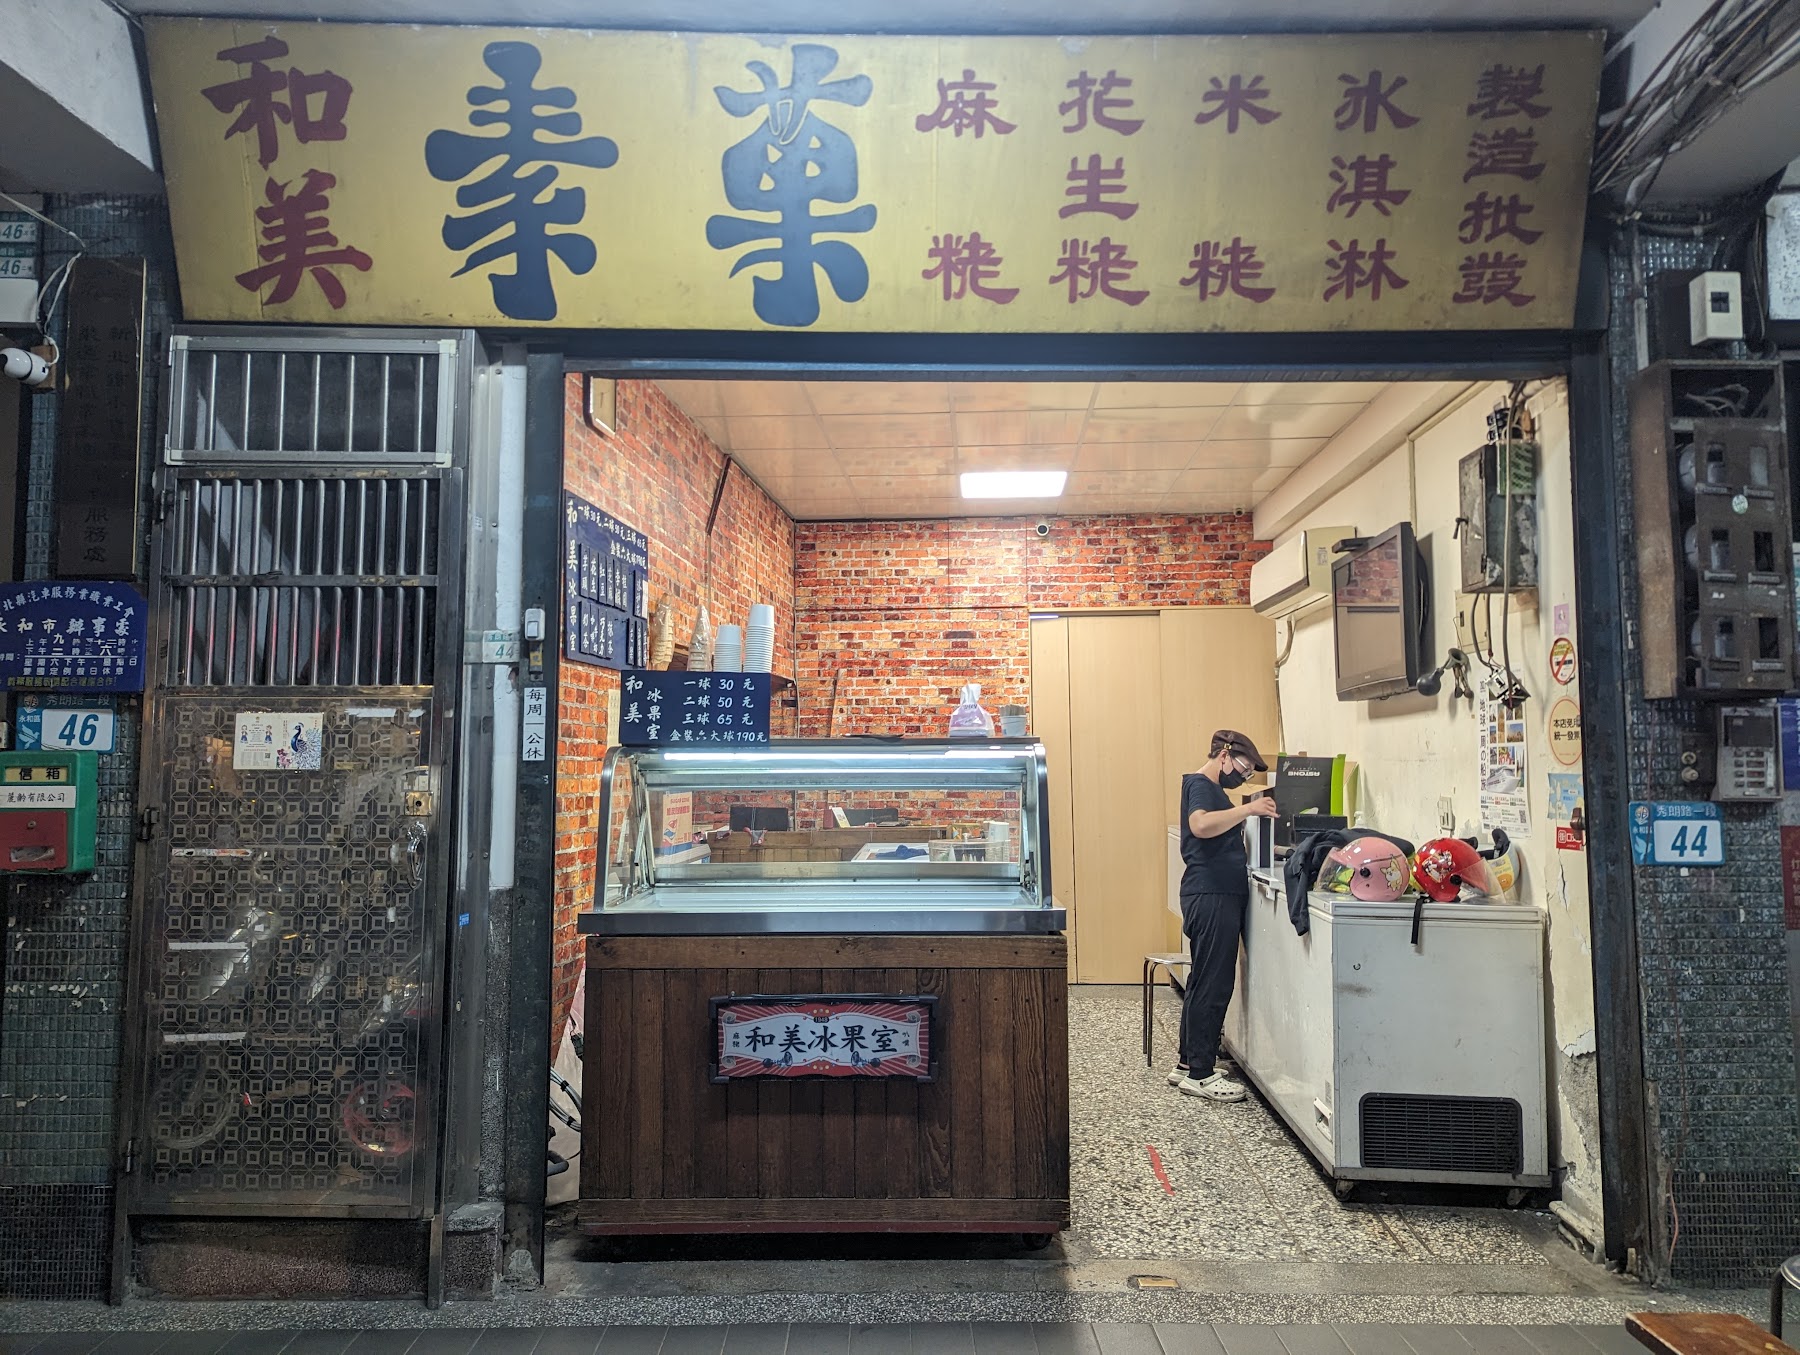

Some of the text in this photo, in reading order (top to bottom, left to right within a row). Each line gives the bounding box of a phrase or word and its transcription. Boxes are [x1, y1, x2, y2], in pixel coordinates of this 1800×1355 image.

[201, 36, 373, 309] 和美
[1322, 70, 1419, 301] 冰淇淋
[1452, 64, 1552, 307] 製造批發
[567, 499, 578, 651] 和美冰果室
[46, 694, 110, 706] 秀朗路一段
[624, 675, 643, 723] 和美
[647, 688, 663, 740] 冰果室
[58, 714, 99, 746] 46
[525, 689, 545, 759] 每周一公休
[19, 767, 60, 780] 信箱
[1656, 804, 1717, 817] 秀朗路一段
[1671, 825, 1708, 857] 44
[745, 1024, 899, 1053] 和美冰果室
